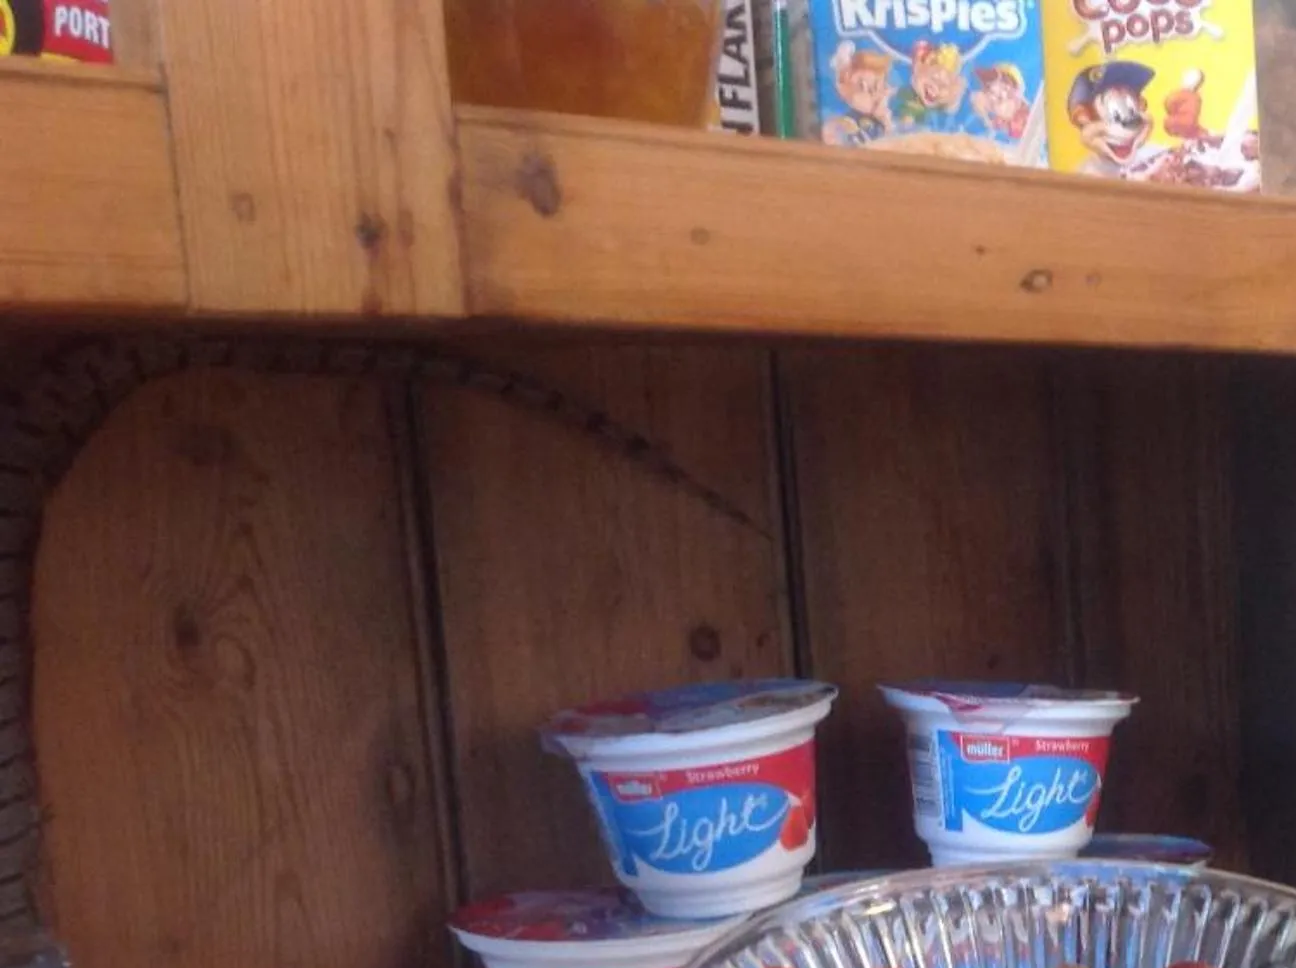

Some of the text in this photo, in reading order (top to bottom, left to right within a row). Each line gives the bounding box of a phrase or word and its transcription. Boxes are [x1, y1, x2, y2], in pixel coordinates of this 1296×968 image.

[54, 5, 110, 49] PORT
[1101, 9, 1194, 53] pops
[1035, 739, 1089, 752] Strawberry
[685, 762, 760, 784] Strawberry
[963, 764, 1096, 833] Light
[624, 794, 790, 872] Light
